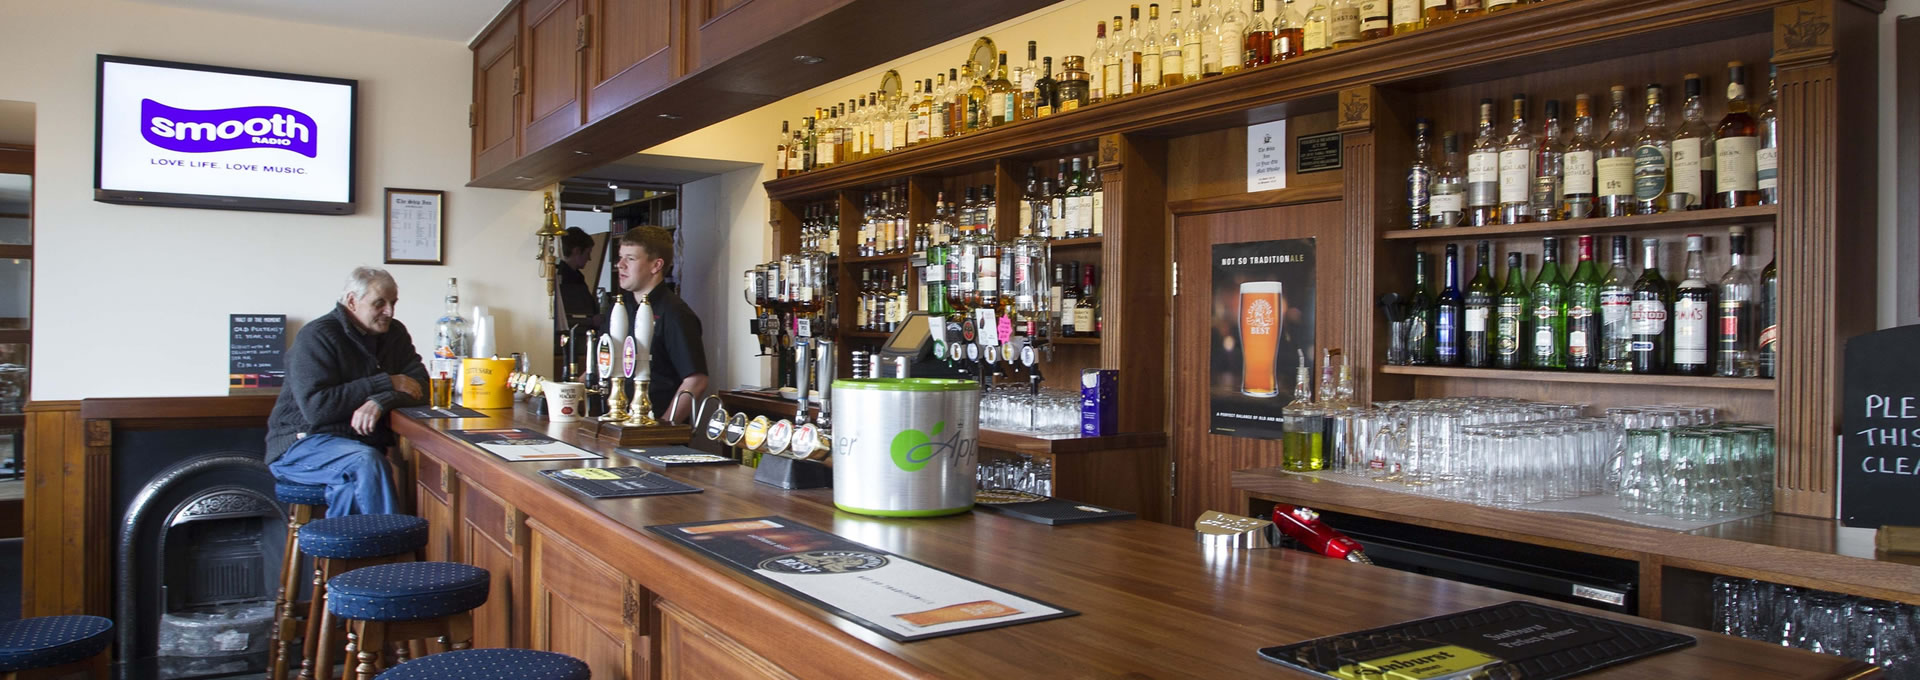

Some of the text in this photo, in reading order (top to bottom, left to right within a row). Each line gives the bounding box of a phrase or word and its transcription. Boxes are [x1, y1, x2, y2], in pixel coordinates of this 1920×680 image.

[151, 114, 309, 143] smooth
[252, 137, 291, 146] RADIO
[151, 158, 308, 174] LOVE LIFE. LOVE MUSIC.
[1222, 254, 1304, 266] NOT SO TRADITIONALE
[1251, 327, 1270, 335] BEST
[1866, 394, 1918, 418] PLE
[776, 558, 820, 573] BEST
